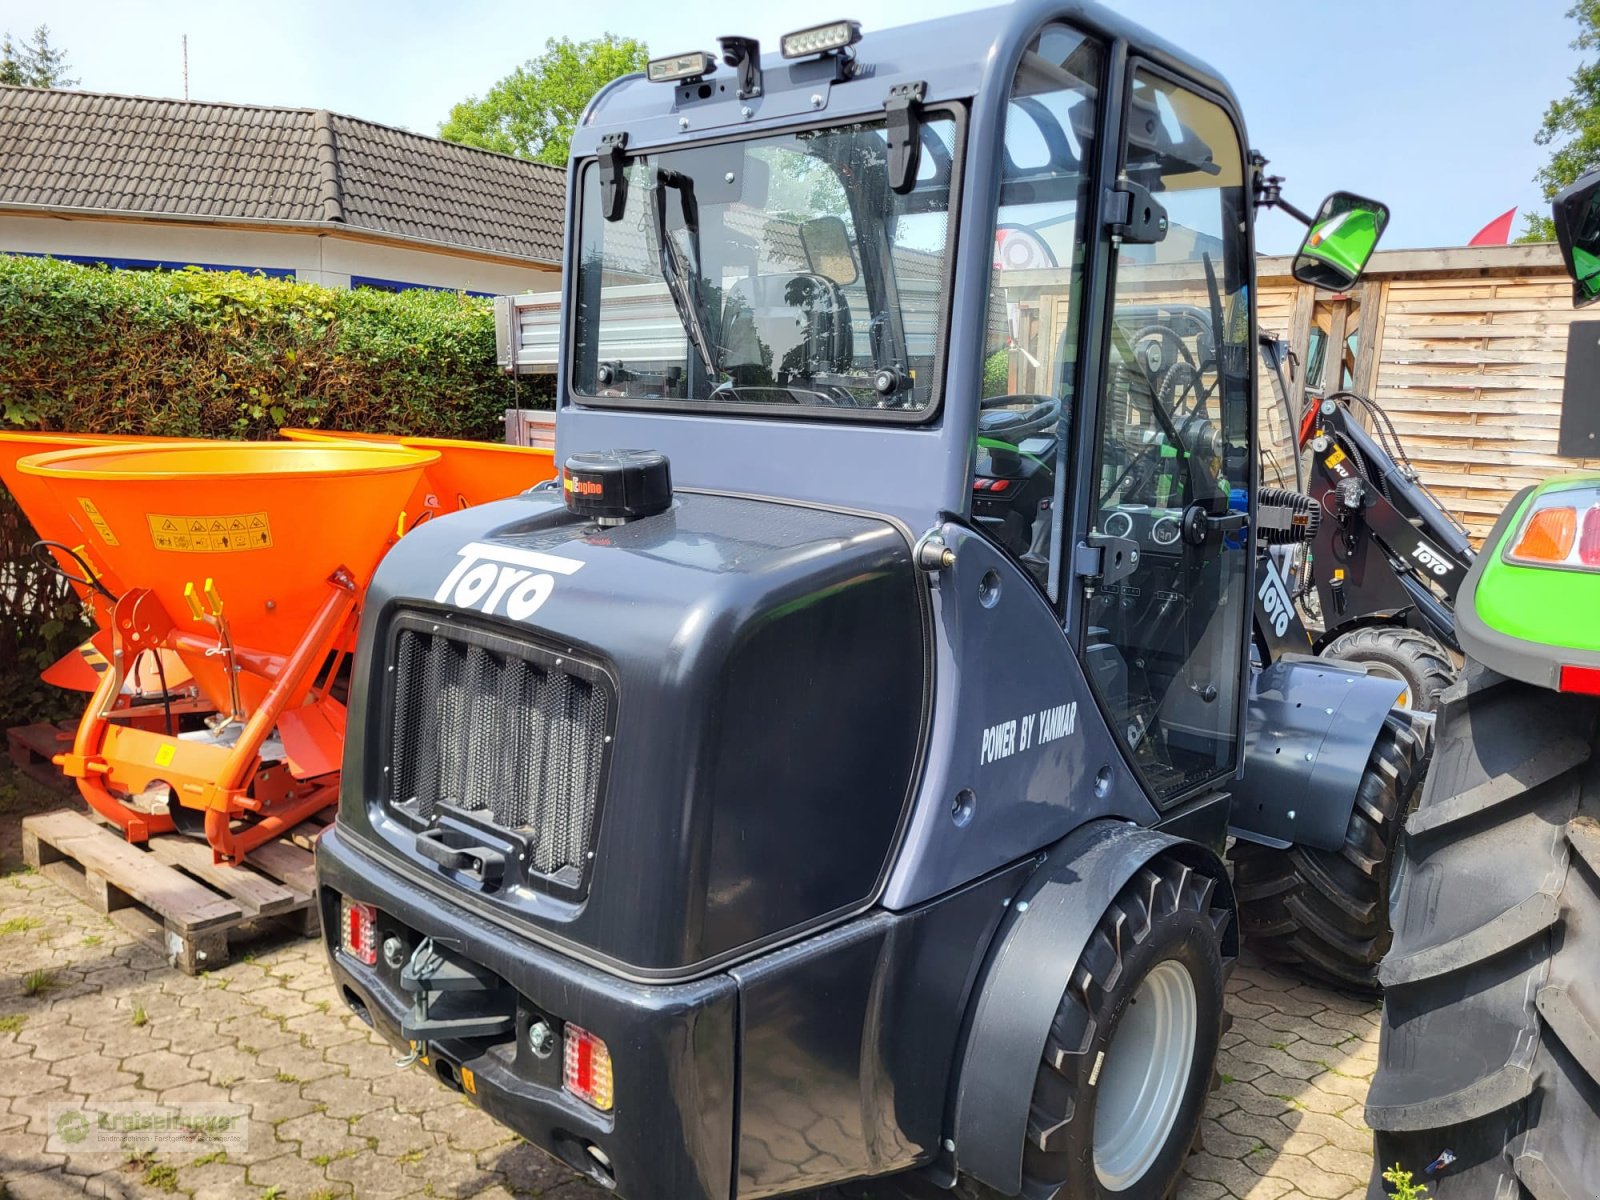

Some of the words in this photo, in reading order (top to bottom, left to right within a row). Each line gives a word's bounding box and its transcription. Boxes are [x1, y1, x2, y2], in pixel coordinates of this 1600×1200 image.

[434, 541, 586, 621] TOYO
[1411, 540, 1454, 575] TOYO
[1258, 559, 1296, 638] TOYO
[980, 719, 1017, 766] POWER
[1019, 713, 1036, 752] BY
[1038, 701, 1077, 745] YANMAR
